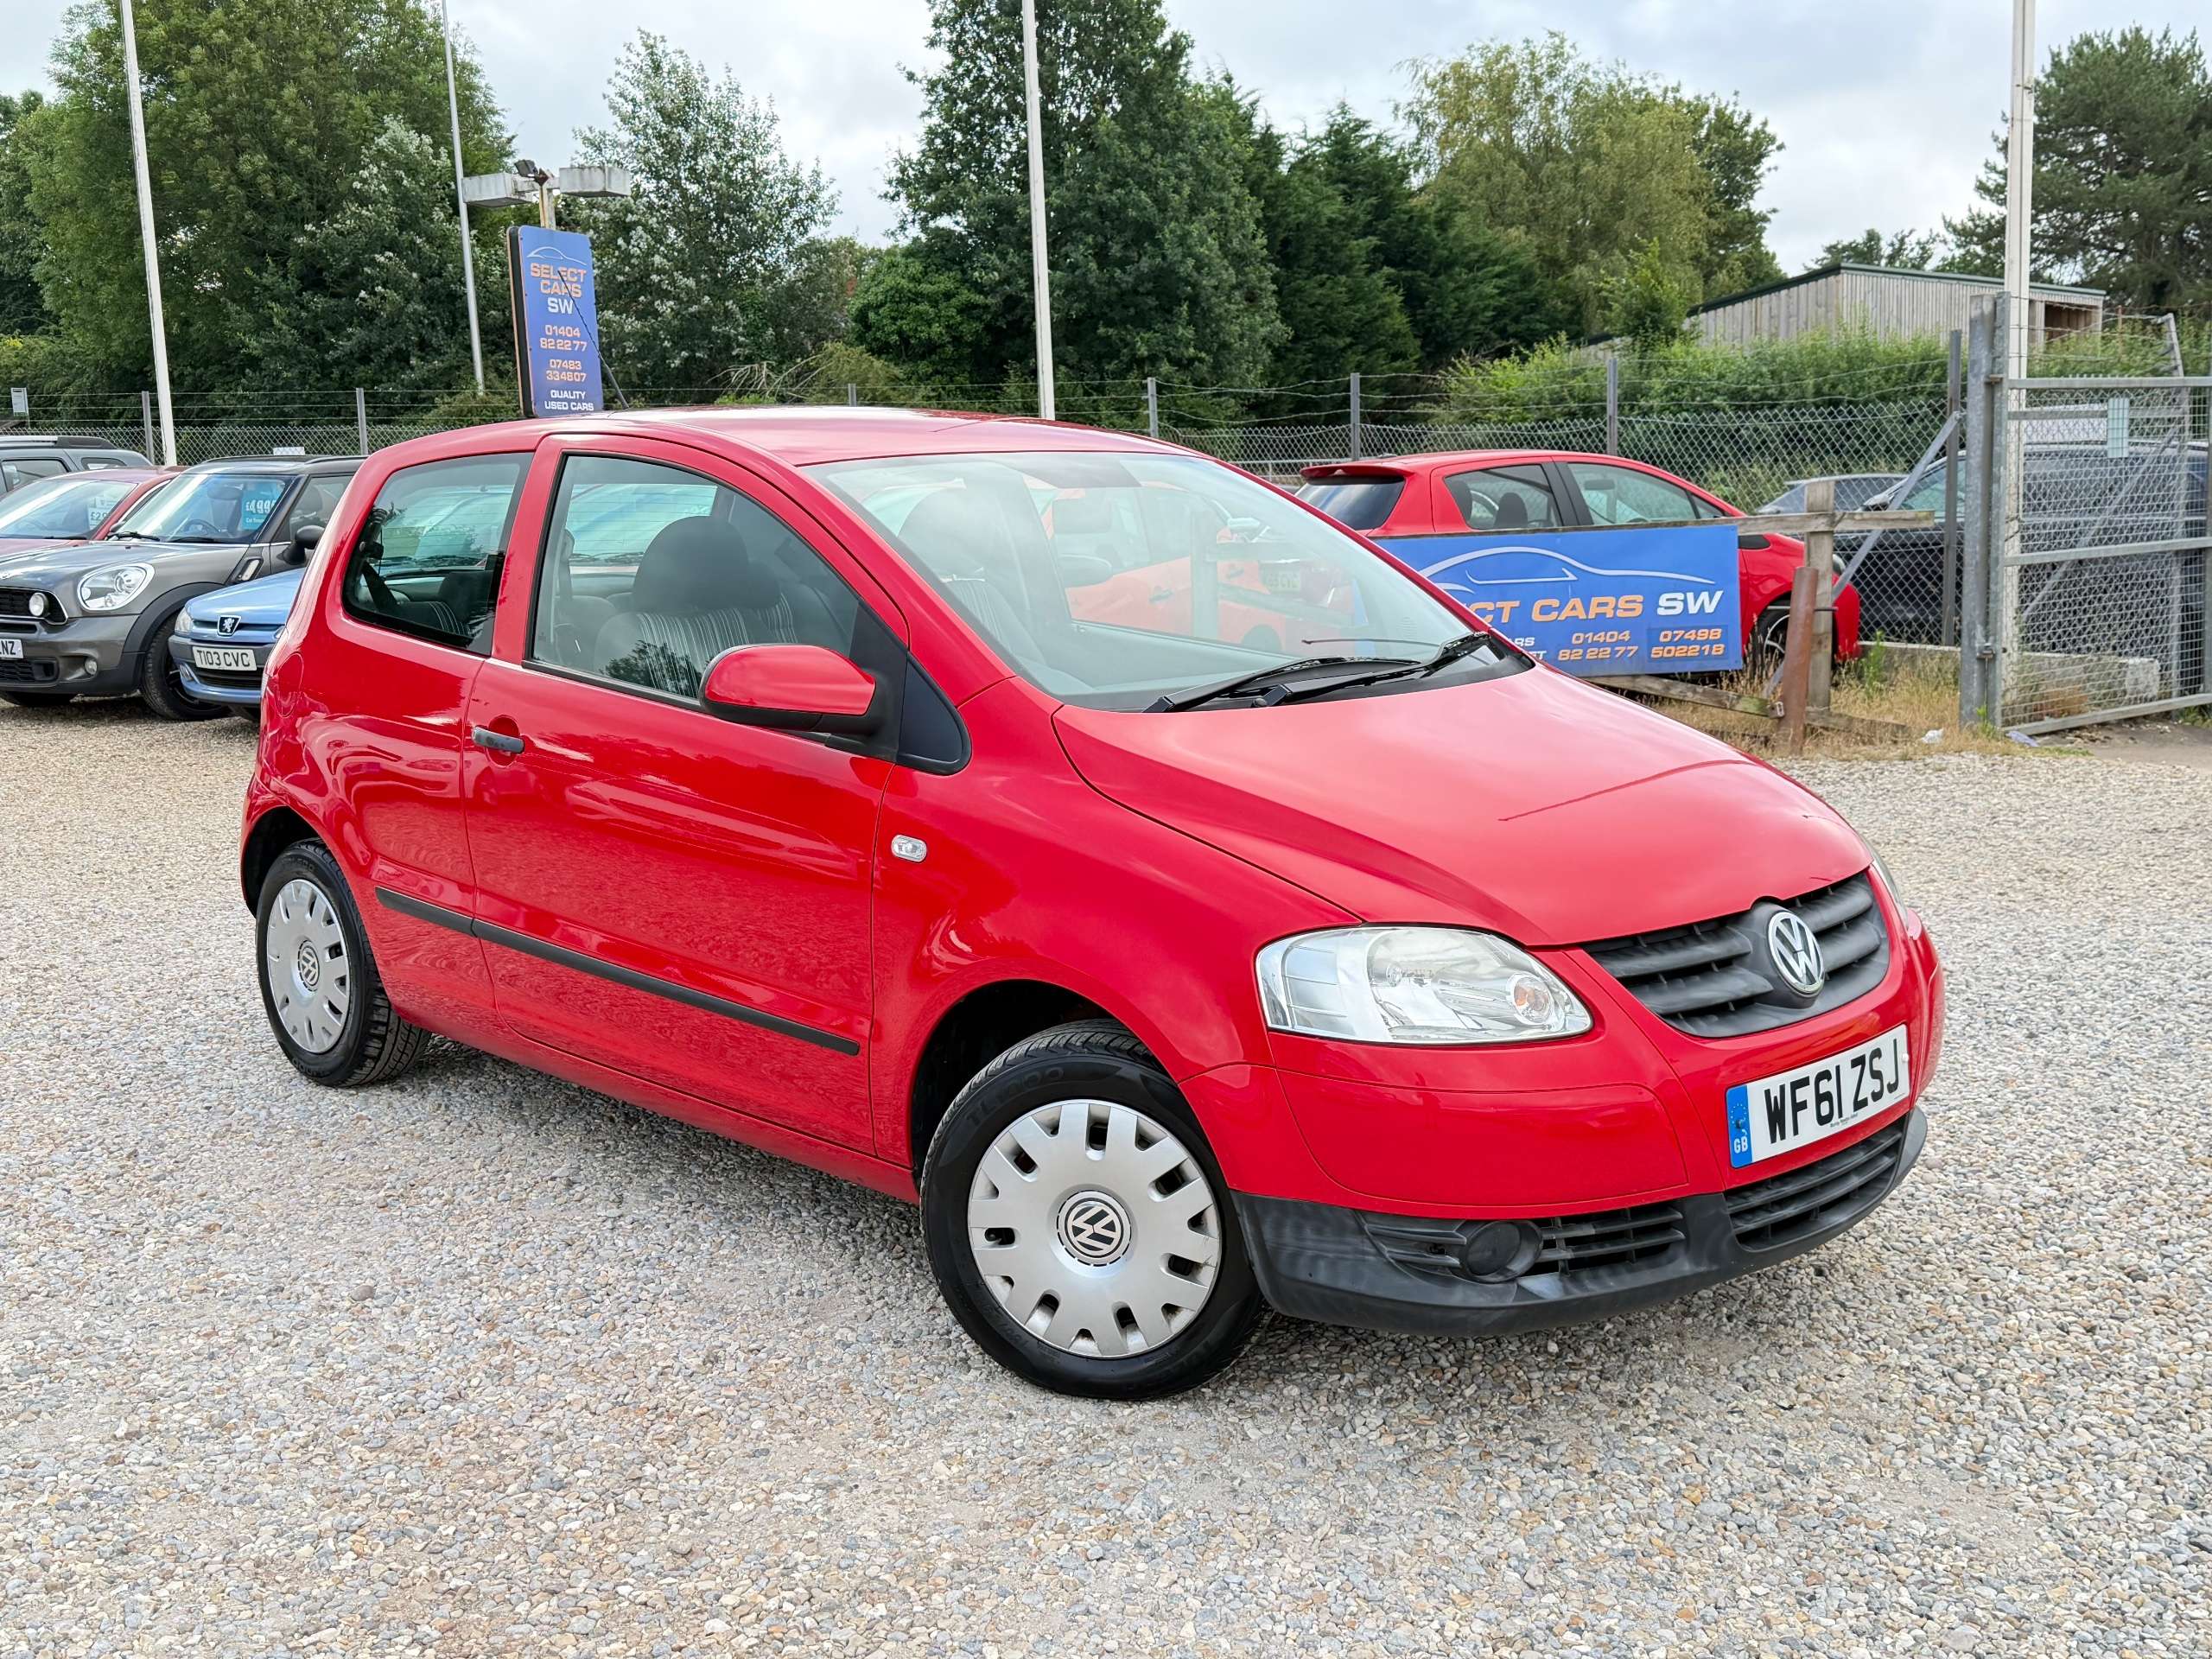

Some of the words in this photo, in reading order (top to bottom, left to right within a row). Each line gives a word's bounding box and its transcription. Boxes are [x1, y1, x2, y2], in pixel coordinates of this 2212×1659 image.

[530, 262, 587, 283] SELECT
[539, 279, 582, 298] CARS
[547, 296, 574, 315] SW
[544, 324, 582, 338] 01404
[550, 389, 587, 399] QUALITY
[544, 400, 569, 410] USED
[570, 401, 594, 411] CARS
[1464, 601, 1521, 623] CT
[1531, 594, 1643, 622] CARS
[1656, 590, 1724, 616] SW
[1571, 630, 1631, 645] 01404
[1659, 628, 1722, 642] 07498
[0, 640, 16, 655] NZ
[1650, 644, 1726, 658] 502218
[223, 652, 251, 667] CVC
[1764, 1064, 1843, 1145] WF61
[1850, 1038, 1899, 1113] ZSJ
[1733, 1135, 1749, 1154] GB
